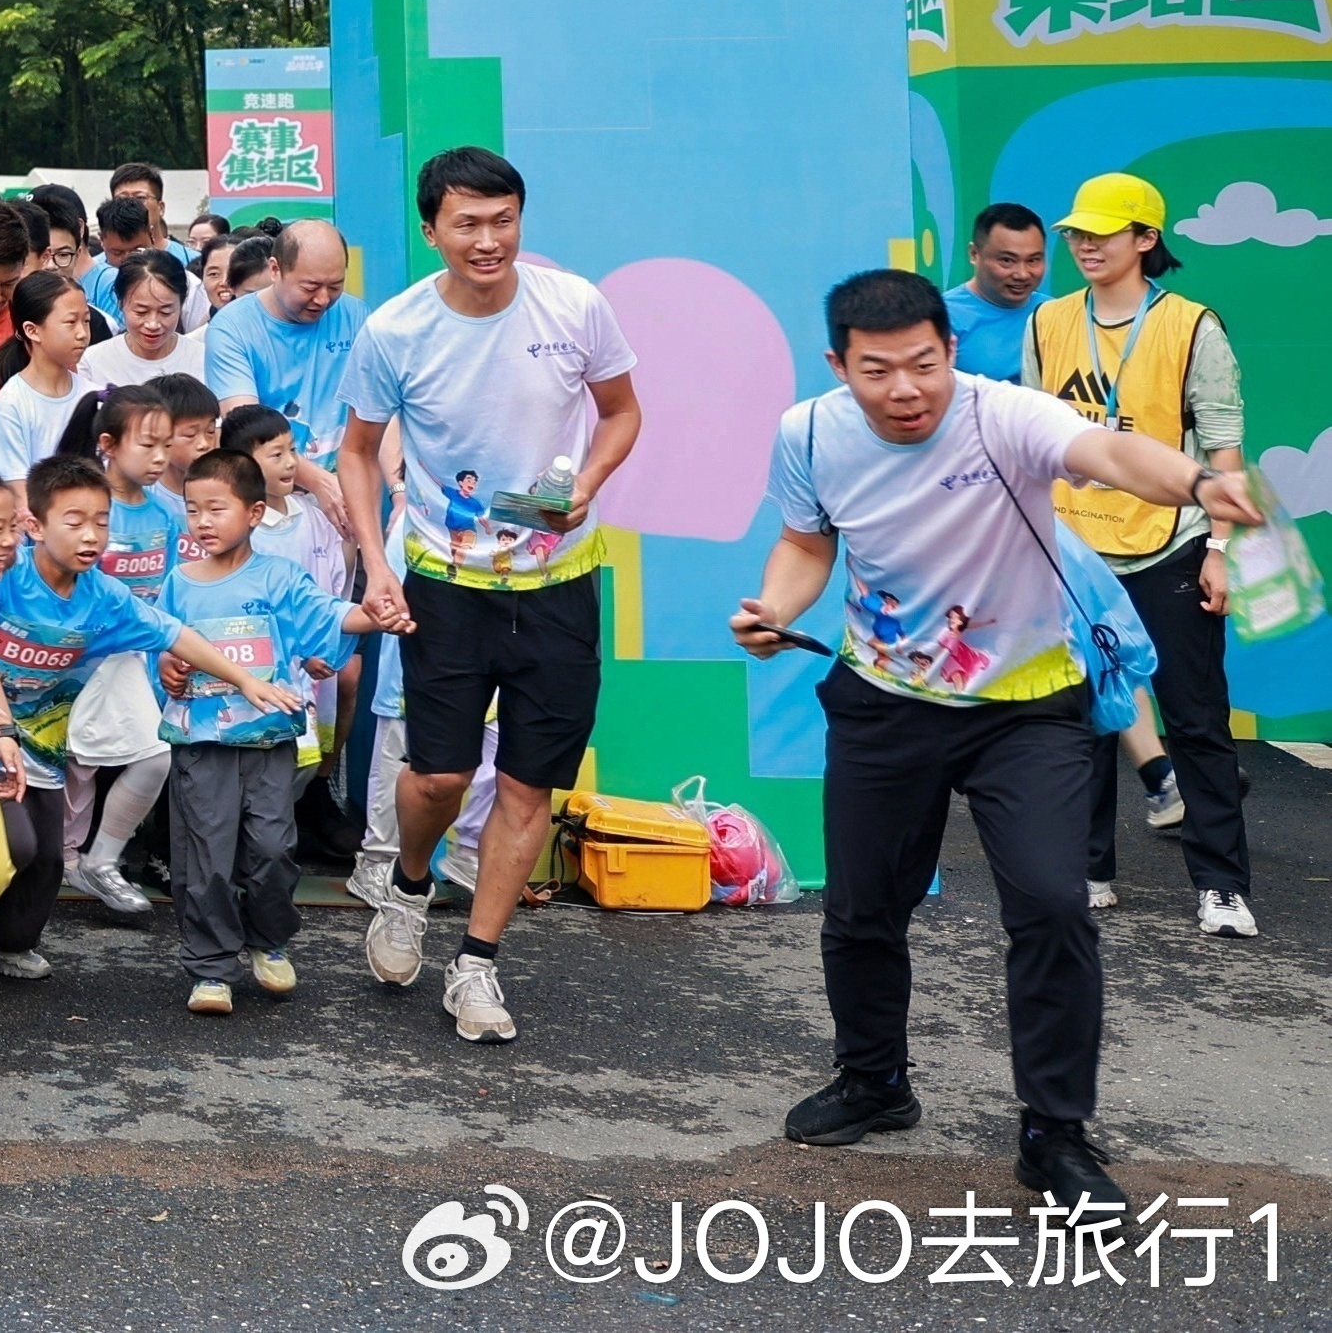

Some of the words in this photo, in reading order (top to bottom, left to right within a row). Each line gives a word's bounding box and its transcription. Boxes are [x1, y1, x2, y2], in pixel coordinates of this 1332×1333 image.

[243, 92, 295, 110] 竞速跑
[234, 120, 299, 155] 赛事
[224, 148, 320, 189] 集结区
[114, 553, 165, 574] B0062
[3, 641, 74, 667] B0068
